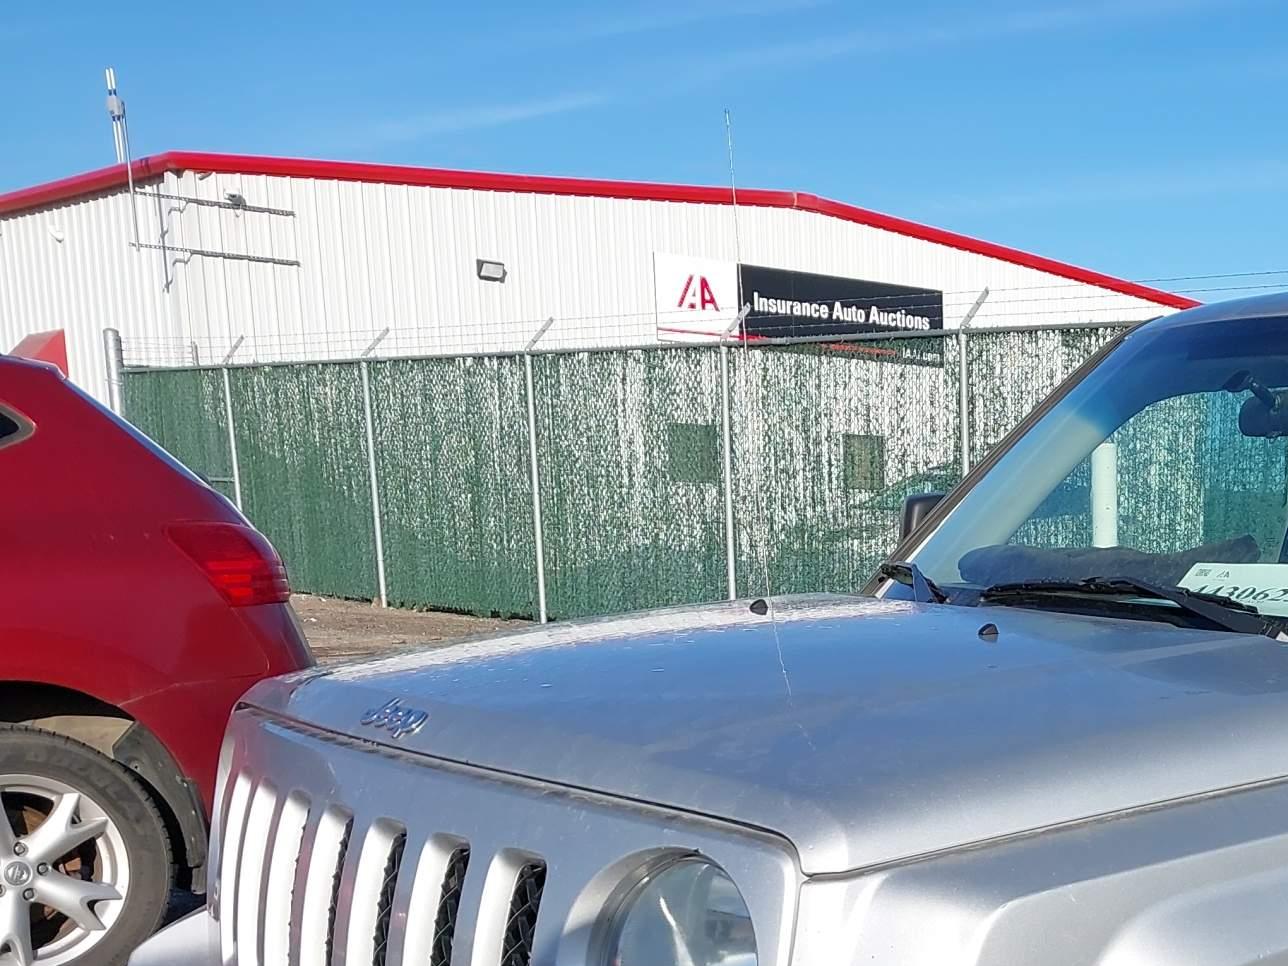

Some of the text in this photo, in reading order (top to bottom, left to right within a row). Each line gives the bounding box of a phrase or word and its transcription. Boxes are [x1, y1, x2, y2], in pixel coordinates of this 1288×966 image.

[753, 291, 930, 330] Insurance Auto Auctions
[360, 697, 428, 739] Jeep
